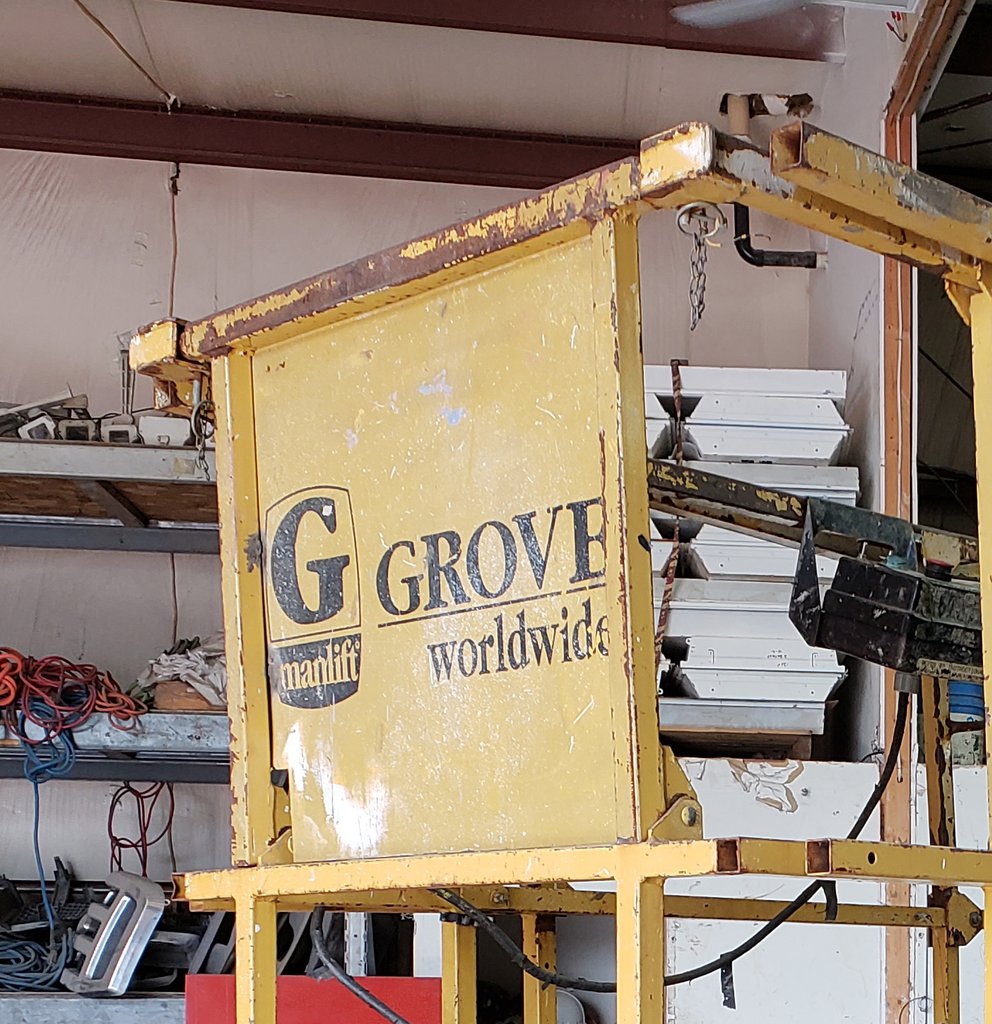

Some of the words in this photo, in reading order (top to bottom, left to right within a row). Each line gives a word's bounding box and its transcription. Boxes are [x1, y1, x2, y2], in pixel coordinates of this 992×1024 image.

[271, 496, 350, 625] G
[376, 497, 607, 616] GROVE
[281, 641, 360, 692] manlift
[427, 601, 610, 686] worldwide
